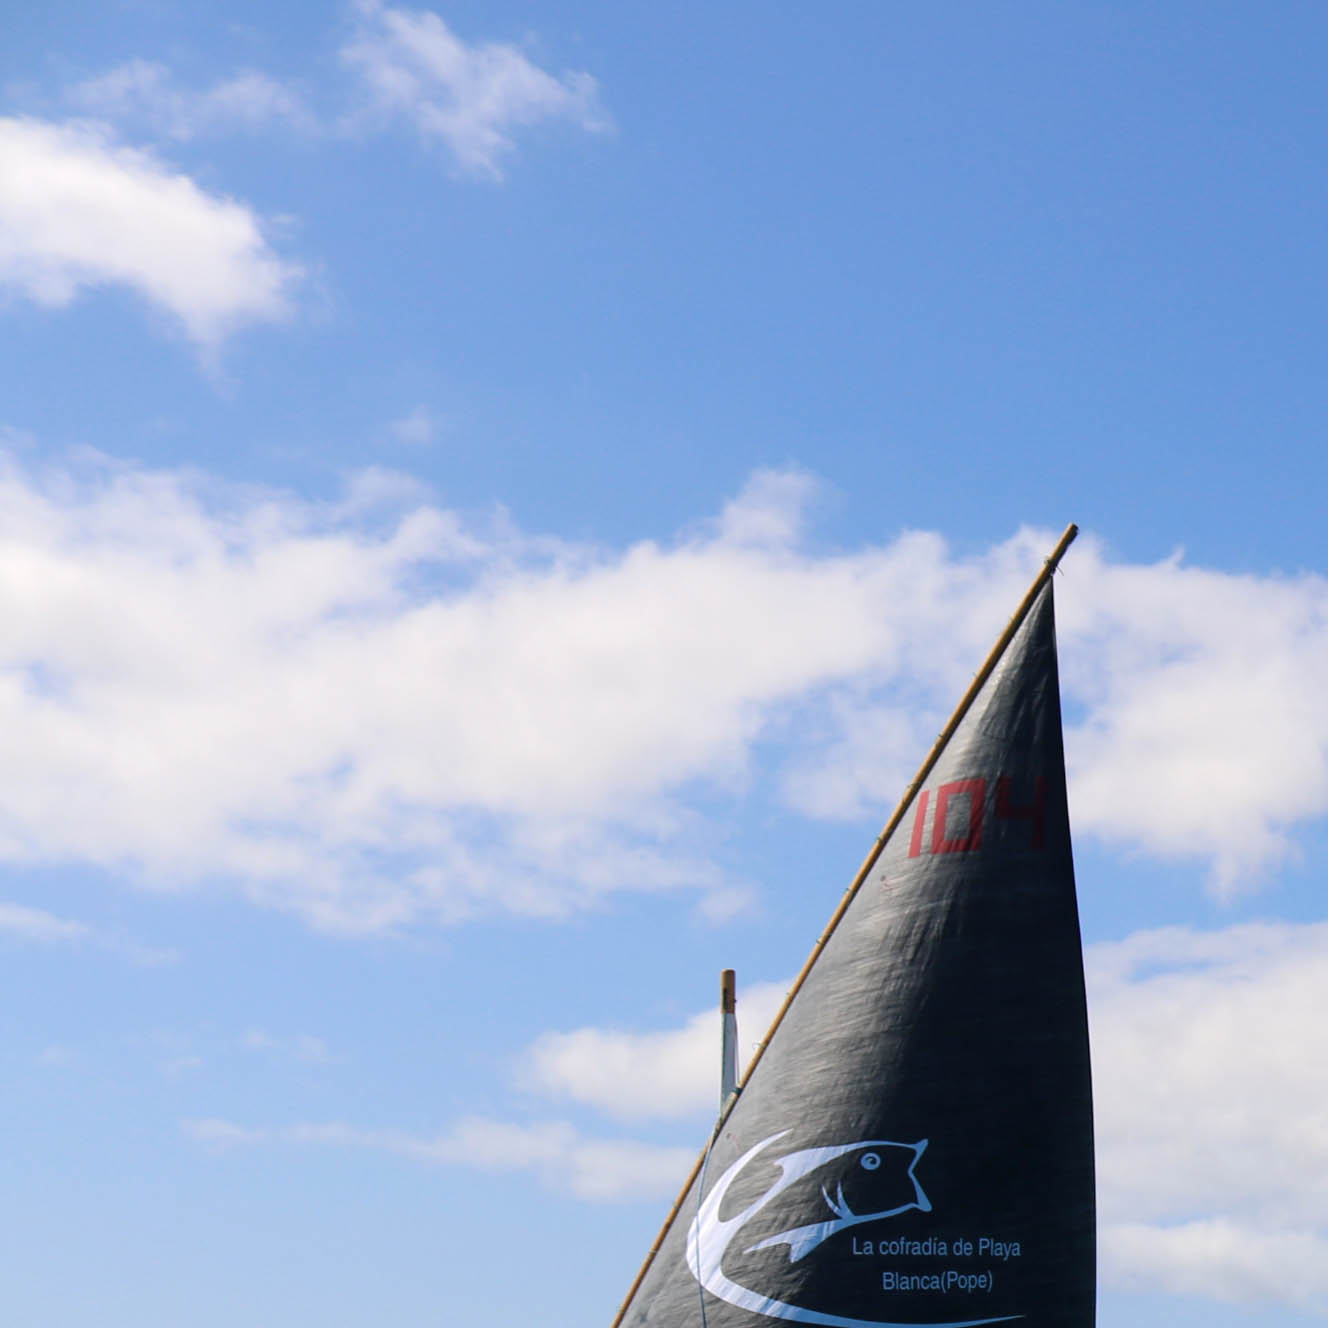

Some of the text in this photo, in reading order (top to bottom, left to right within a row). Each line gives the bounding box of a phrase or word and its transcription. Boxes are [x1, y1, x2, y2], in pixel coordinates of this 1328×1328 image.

[852, 1236, 873, 1255] La
[953, 1237, 973, 1257] de
[978, 1237, 1021, 1261] Playa
